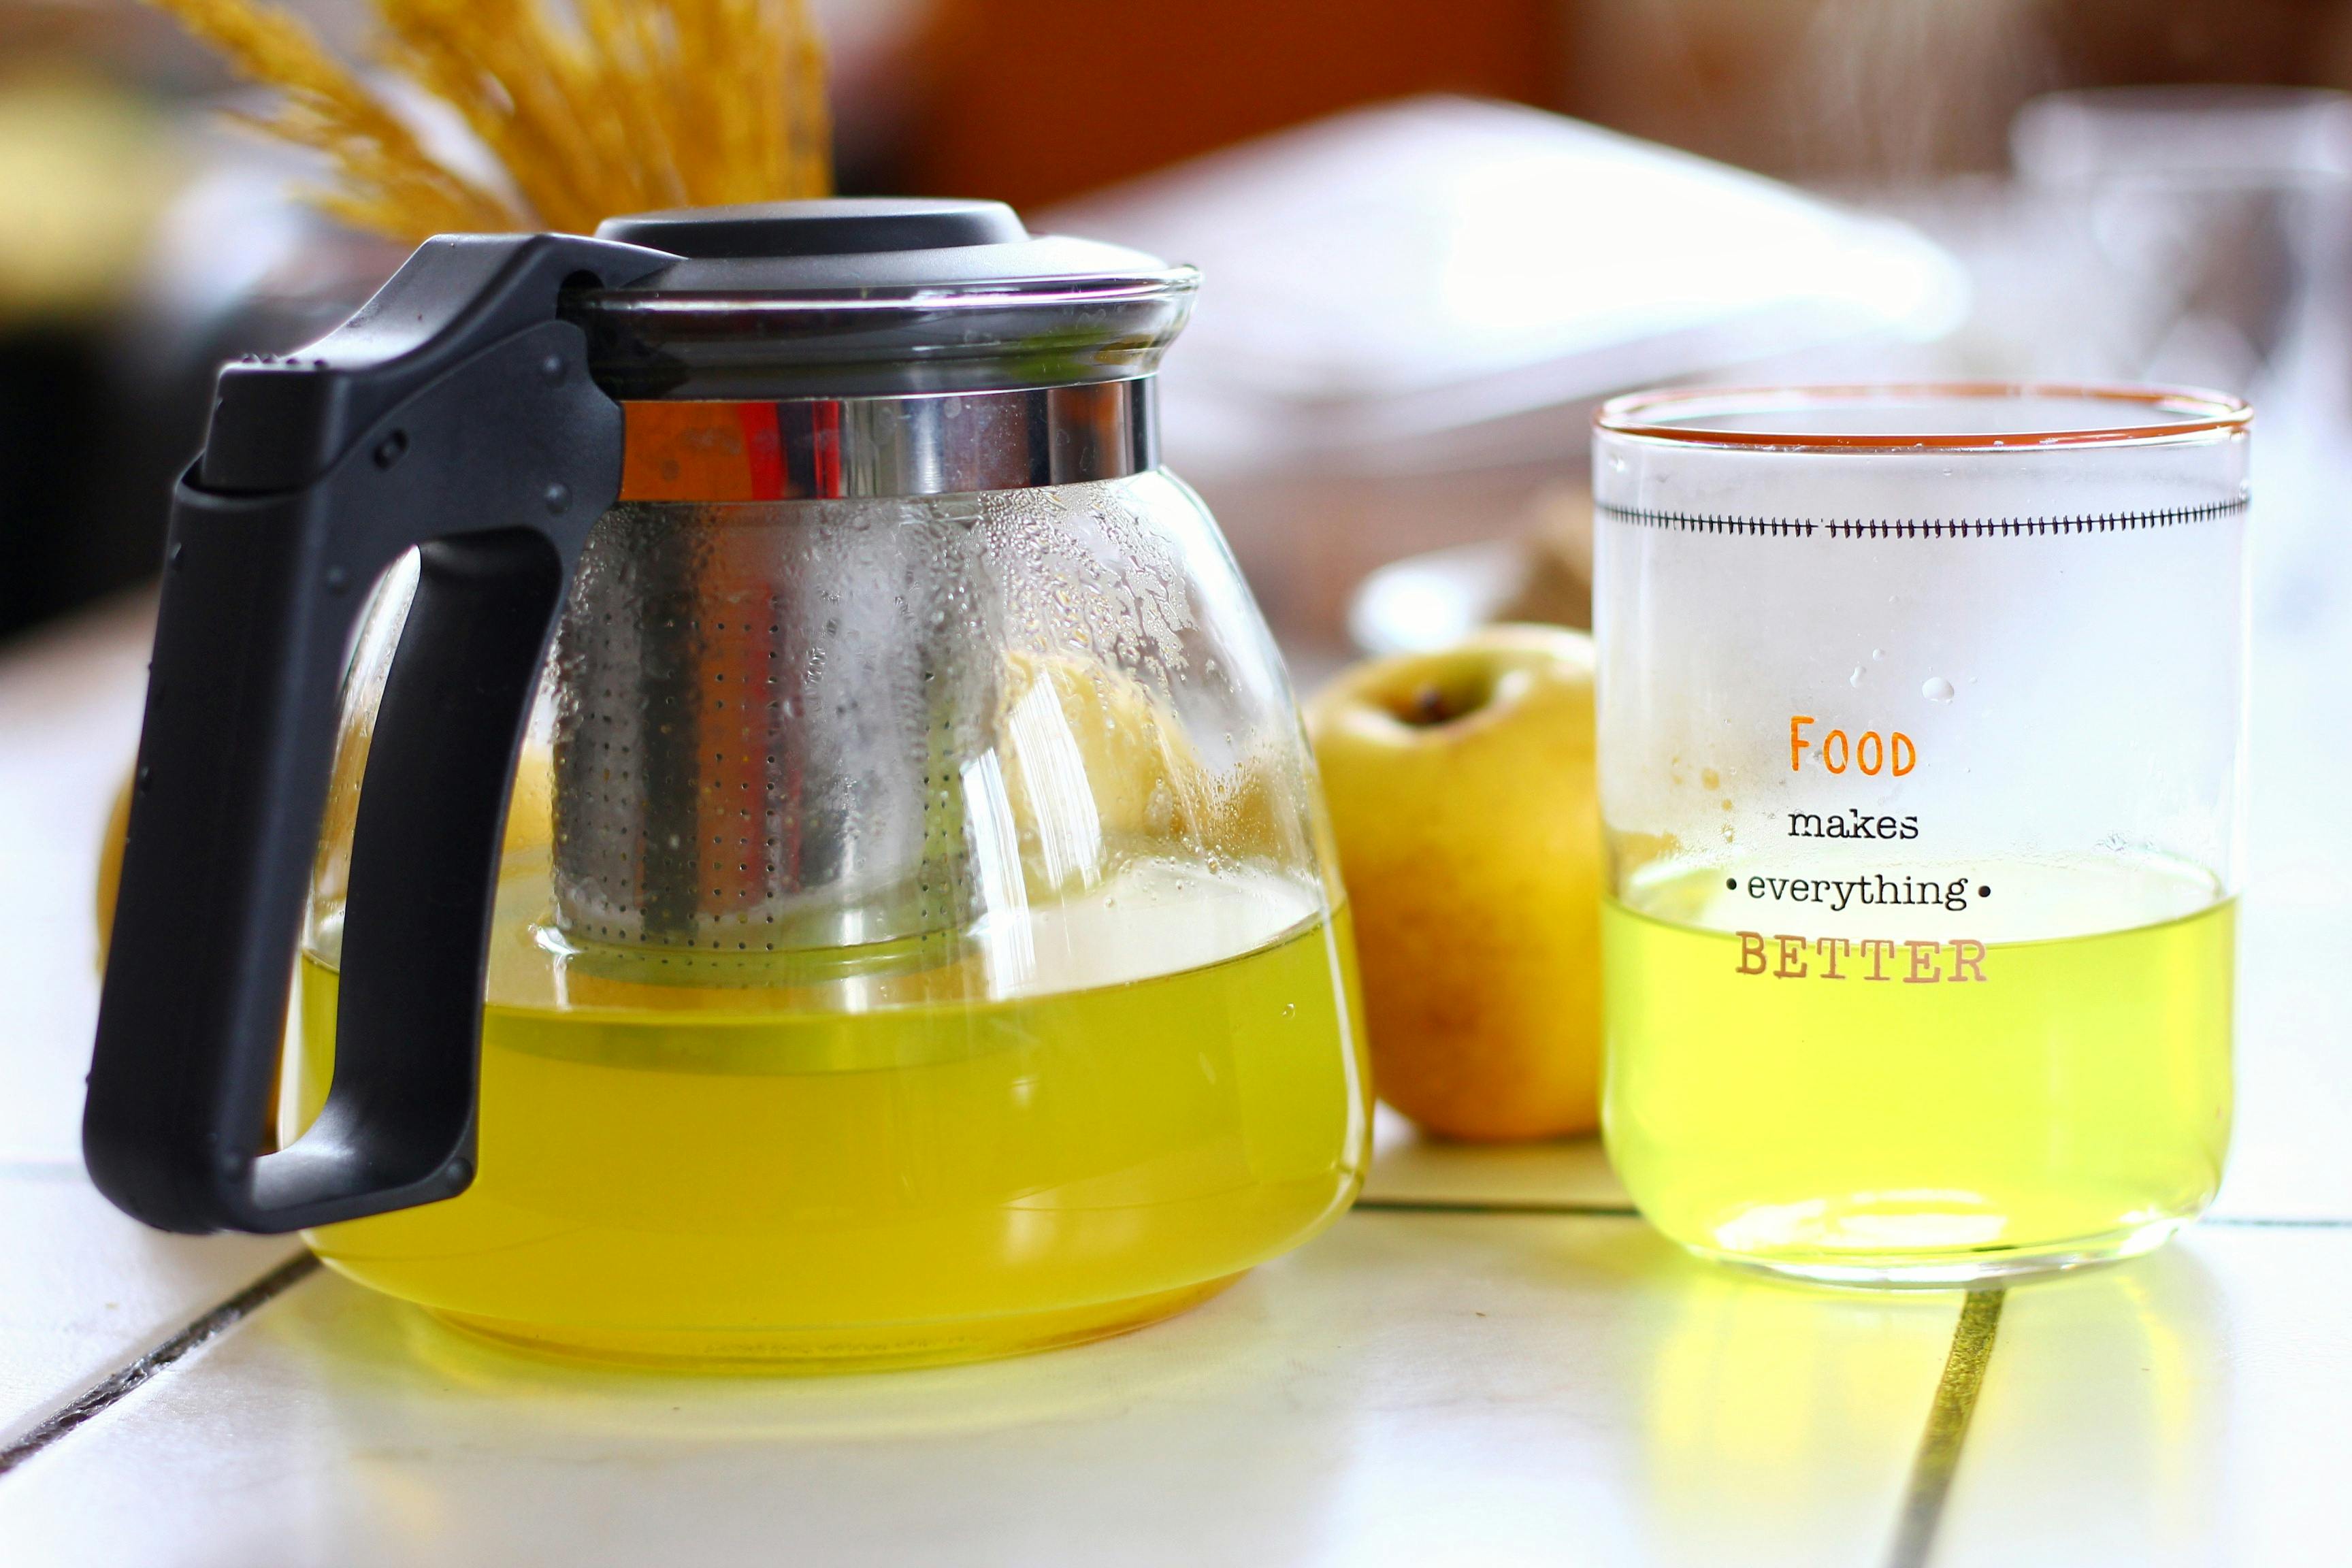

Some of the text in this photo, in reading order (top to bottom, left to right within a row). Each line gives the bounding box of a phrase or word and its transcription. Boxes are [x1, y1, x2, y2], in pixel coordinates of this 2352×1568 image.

[1789, 715, 1916, 777] FOOD
[1787, 808, 1918, 839] makes
[1747, 875, 1969, 911] everything
[1735, 931, 1987, 983] BETTER
